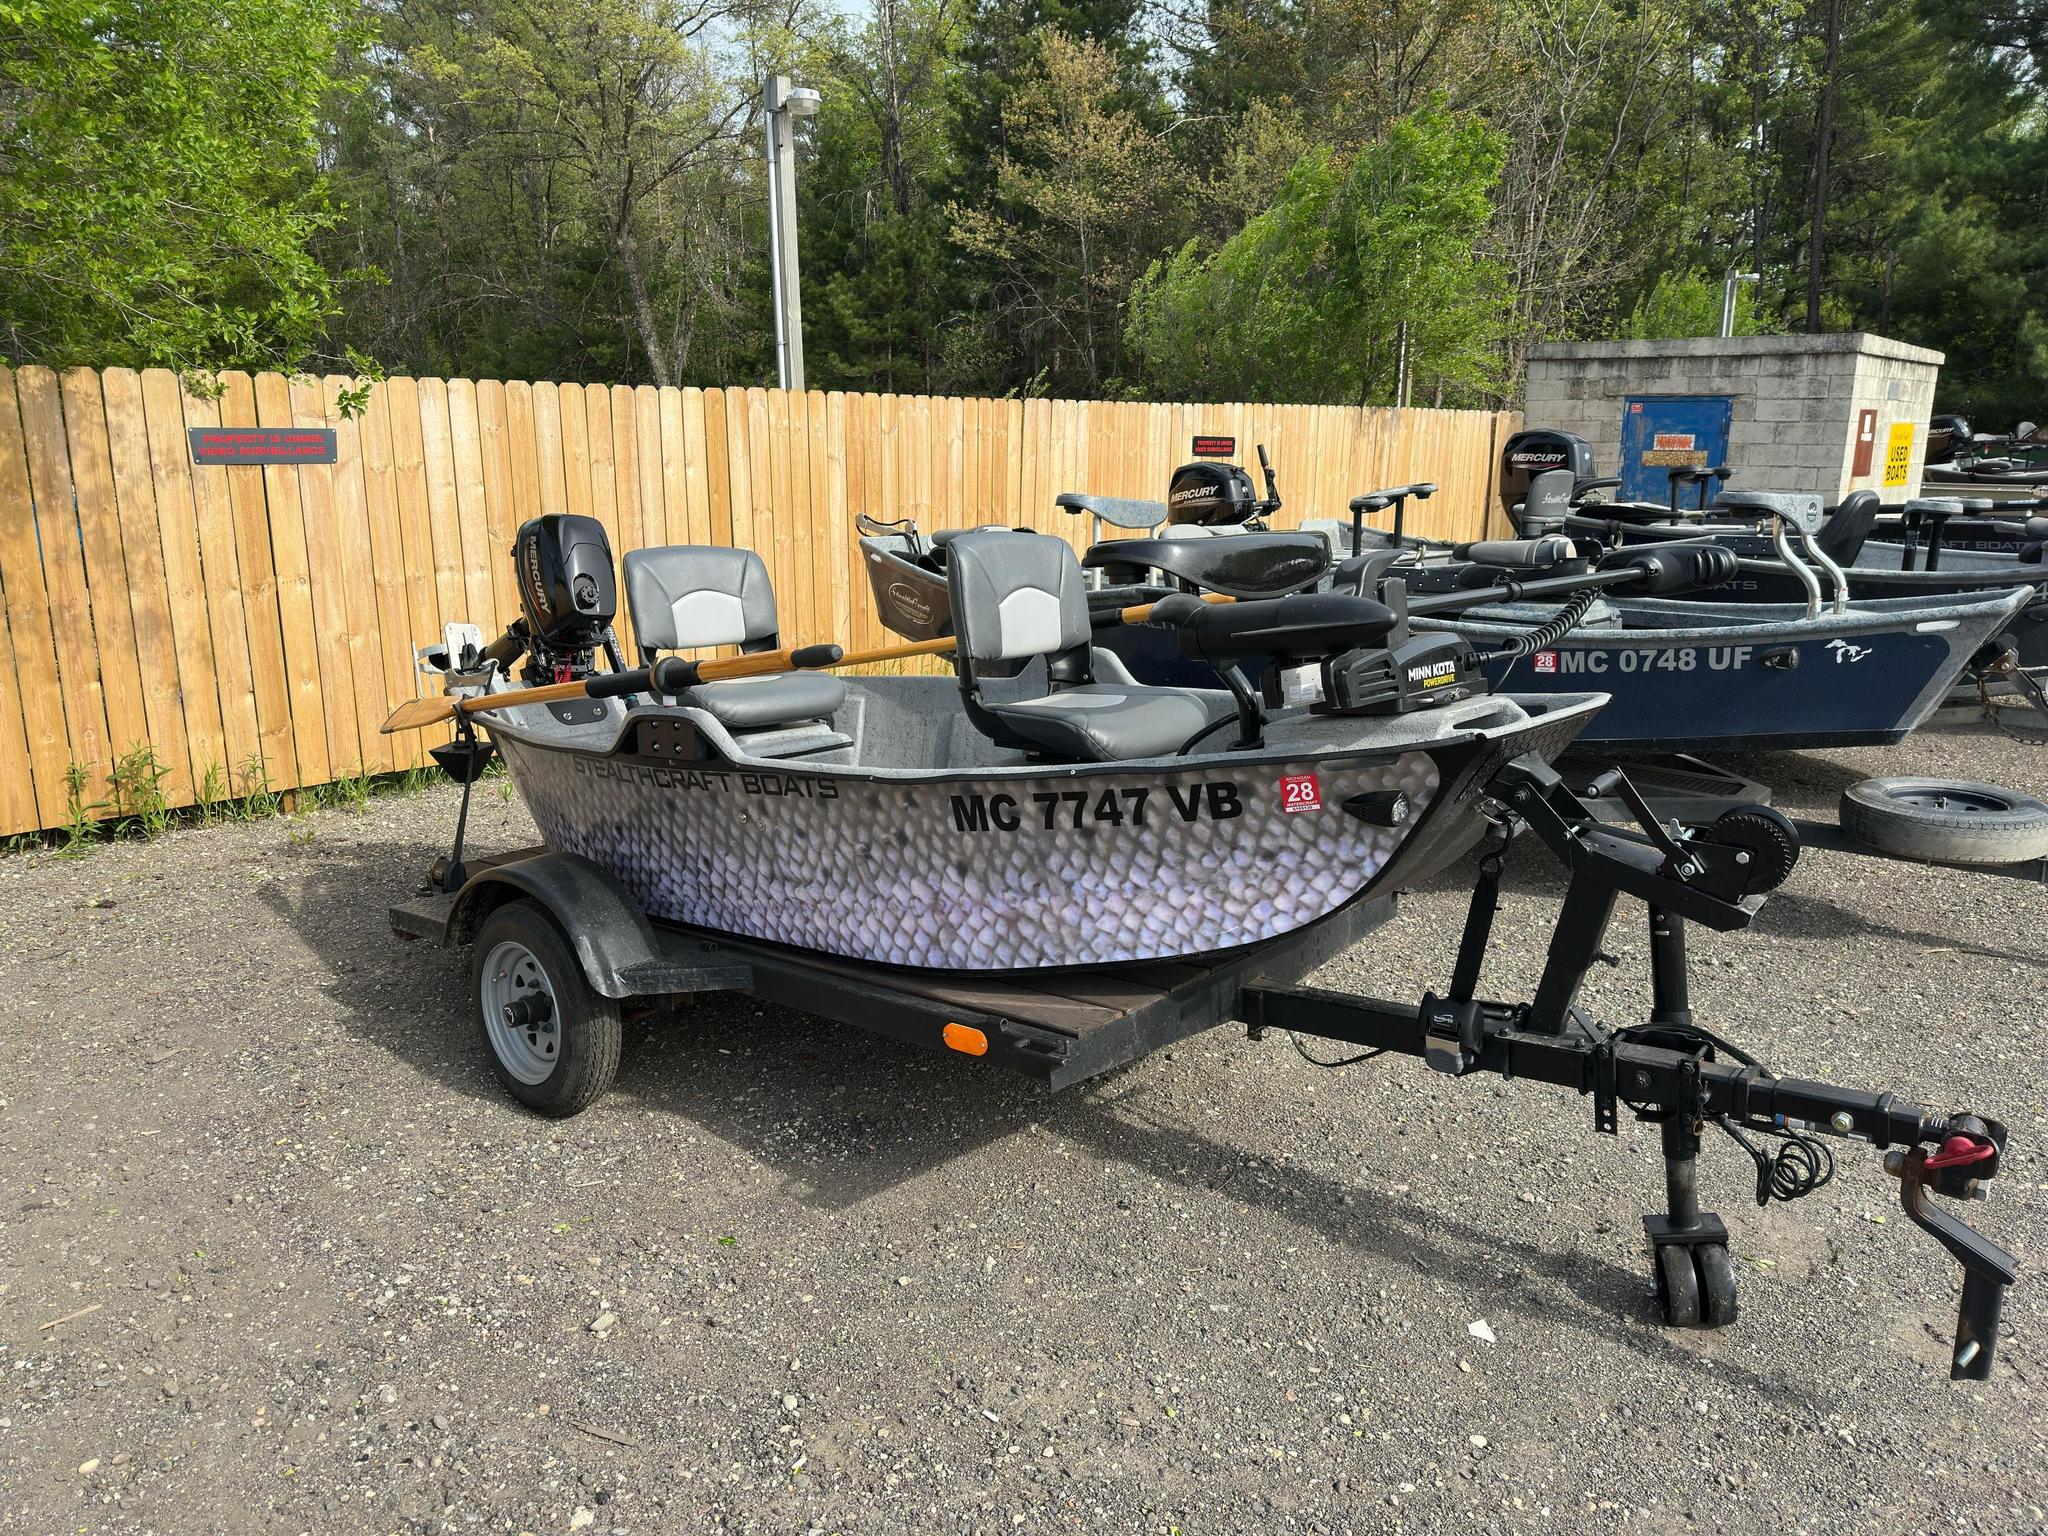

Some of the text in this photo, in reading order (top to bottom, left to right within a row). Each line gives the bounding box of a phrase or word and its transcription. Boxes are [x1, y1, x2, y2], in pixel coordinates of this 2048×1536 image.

[203, 433, 323, 443] PROPERTY IS UNDER
[198, 446, 325, 456] VIDEO SURVEILLANCE
[1510, 453, 1566, 462] MERCURY
[1891, 446, 1908, 462] USED
[1886, 464, 1907, 481] BOATS
[1171, 485, 1219, 502] MERCURY
[1976, 540, 2027, 549] BOAT
[529, 535, 552, 615] MERCURY
[1537, 655, 1554, 667] 28
[1561, 647, 1753, 673] MC 0748 UF
[1408, 660, 1456, 682] MINN KOTA
[1423, 673, 1456, 688] POWERDRIVE
[573, 754, 839, 799] STEALTHCRAFT BOATS
[1286, 782, 1314, 802] 28
[950, 781, 1243, 832] MC 7747 VB
